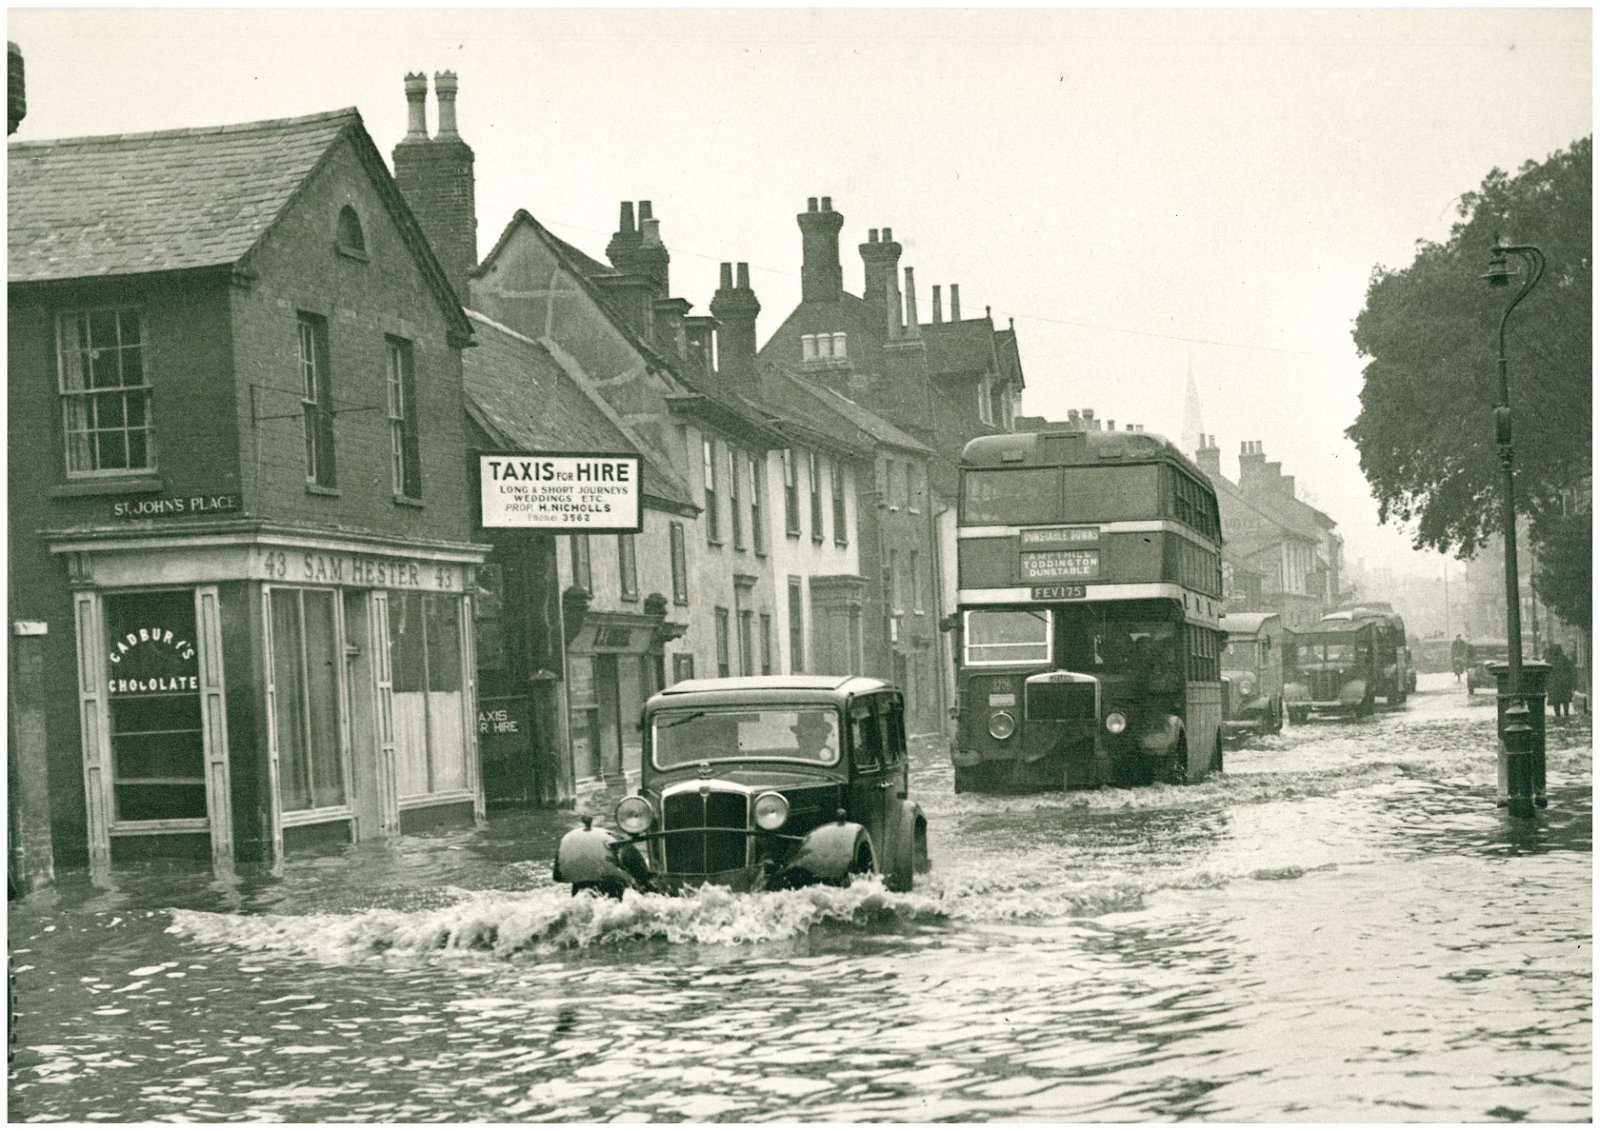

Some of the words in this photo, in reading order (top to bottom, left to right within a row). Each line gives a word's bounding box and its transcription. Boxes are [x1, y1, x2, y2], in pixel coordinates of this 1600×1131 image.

[488, 461, 555, 481] TAXIS
[556, 472, 574, 481] FOR
[576, 463, 629, 482] HIRE
[500, 486, 528, 494] LONG
[532, 486, 537, 494] &
[541, 486, 574, 494] SHORT
[578, 486, 628, 495] JOURNEYS
[514, 494, 572, 502] WEDDINGS
[133, 498, 185, 514] JOHN'S
[190, 496, 237, 511] PLACE
[505, 504, 534, 512] PROP.
[562, 513, 591, 522] 3562
[1023, 558, 1097, 569] TODDINGTON
[263, 551, 287, 578] 43
[303, 553, 344, 581] SAM
[351, 558, 420, 587] HESTER
[434, 567, 454, 589] 43
[1029, 566, 1090, 577] DUNSTABLE
[479, 710, 507, 721] AXIS
[494, 721, 518, 732] HIRE
